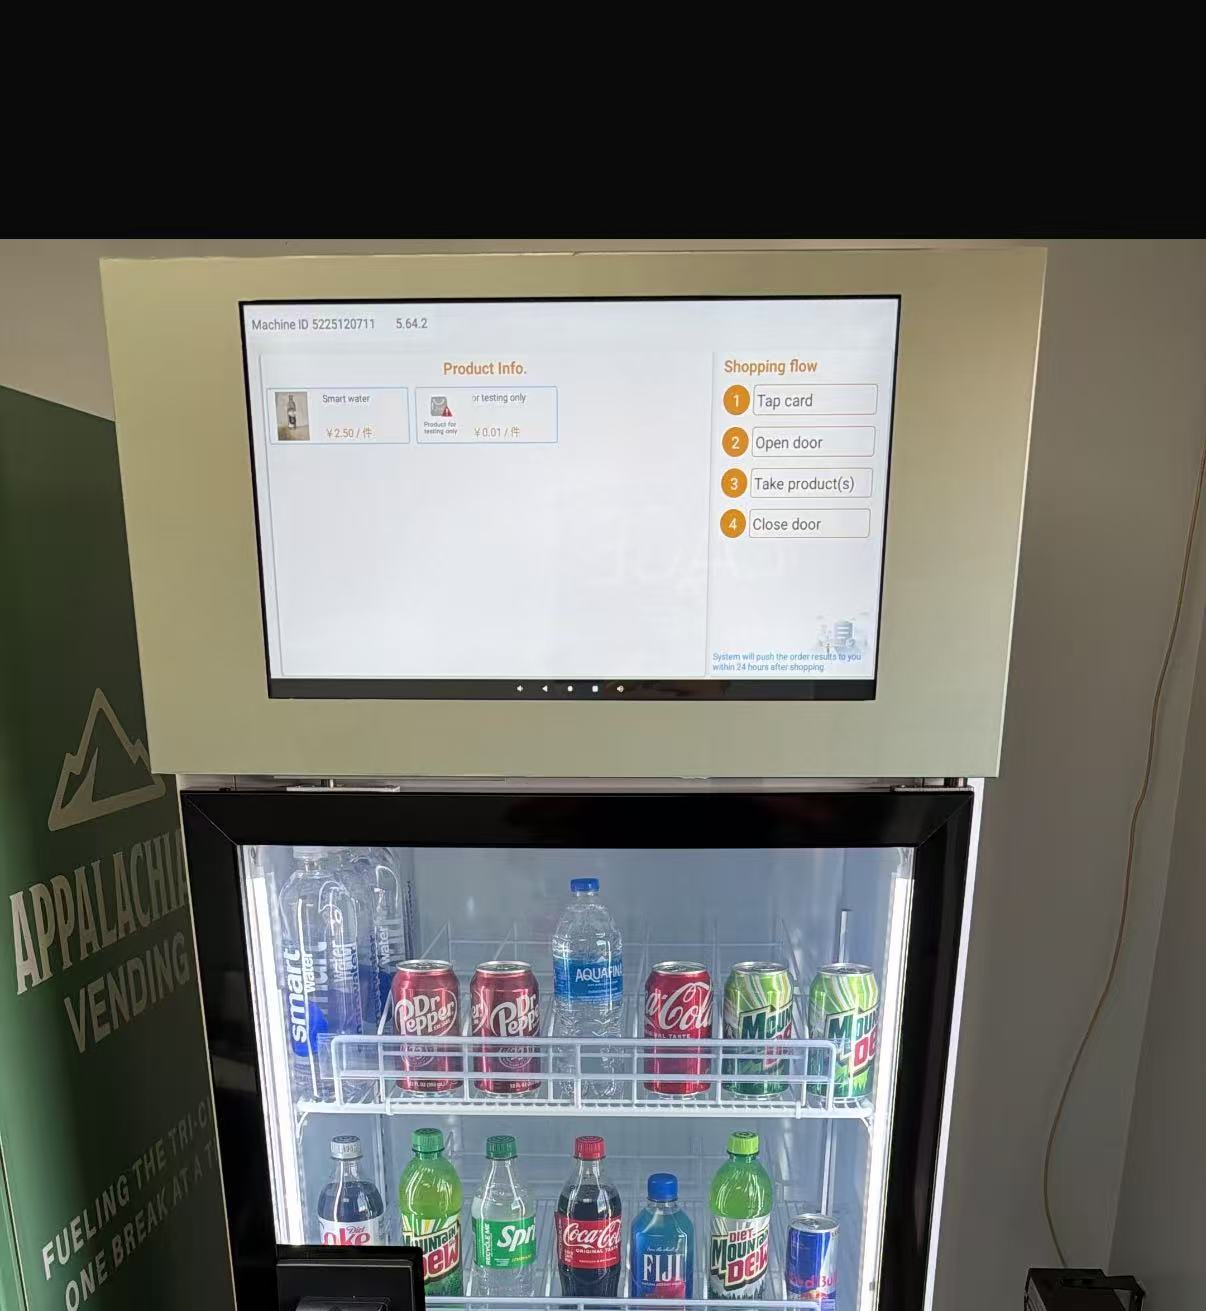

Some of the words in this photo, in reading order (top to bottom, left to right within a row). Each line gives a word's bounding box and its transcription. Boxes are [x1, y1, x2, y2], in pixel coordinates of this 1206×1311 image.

[252, 319, 296, 330] Machine
[298, 319, 309, 330] ID
[312, 318, 375, 330] 5225120711
[395, 317, 428, 330] 5.64.2
[443, 362, 494, 375] Product
[498, 361, 527, 374] Info.
[724, 360, 786, 376] Shopping
[790, 359, 818, 373] flow
[322, 394, 346, 403] Smart
[348, 394, 371, 403] water
[481, 393, 508, 404] testing
[509, 392, 527, 404] only
[732, 394, 740, 408] 1
[757, 394, 781, 410] Tap
[785, 394, 813, 407] card
[731, 436, 740, 450] 2
[755, 437, 789, 452] Open
[793, 436, 823, 449] door
[730, 478, 739, 490] 3
[754, 477, 784, 490] Take
[788, 476, 855, 493] product(s)
[728, 518, 737, 531] 4
[752, 518, 788, 531] Close
[792, 517, 822, 531] door
[712, 653, 740, 662] System
[742, 652, 754, 661] will
[756, 653, 775, 662] push
[776, 652, 788, 661] the
[789, 652, 810, 661] order
[811, 652, 837, 661] results
[838, 652, 846, 661] to
[847, 653, 861, 662] you
[770, 663, 788, 671] after
[789, 663, 824, 673] shopping
[303, 953, 316, 993] water
[63, 931, 191, 1054] VENDING
[283, 948, 307, 1043] smart
[413, 994, 440, 1017] Dr
[517, 994, 536, 1017] Dr
[395, 998, 455, 1037] Pepper
[41, 1174, 130, 1281] FUELING
[131, 1138, 168, 1191] THE
[111, 1186, 168, 1269] BREAK
[171, 1167, 189, 1206] AT
[194, 1158, 204, 1183] A
[346, 1226, 366, 1235] Diet
[643, 1254, 683, 1282] FIJI
